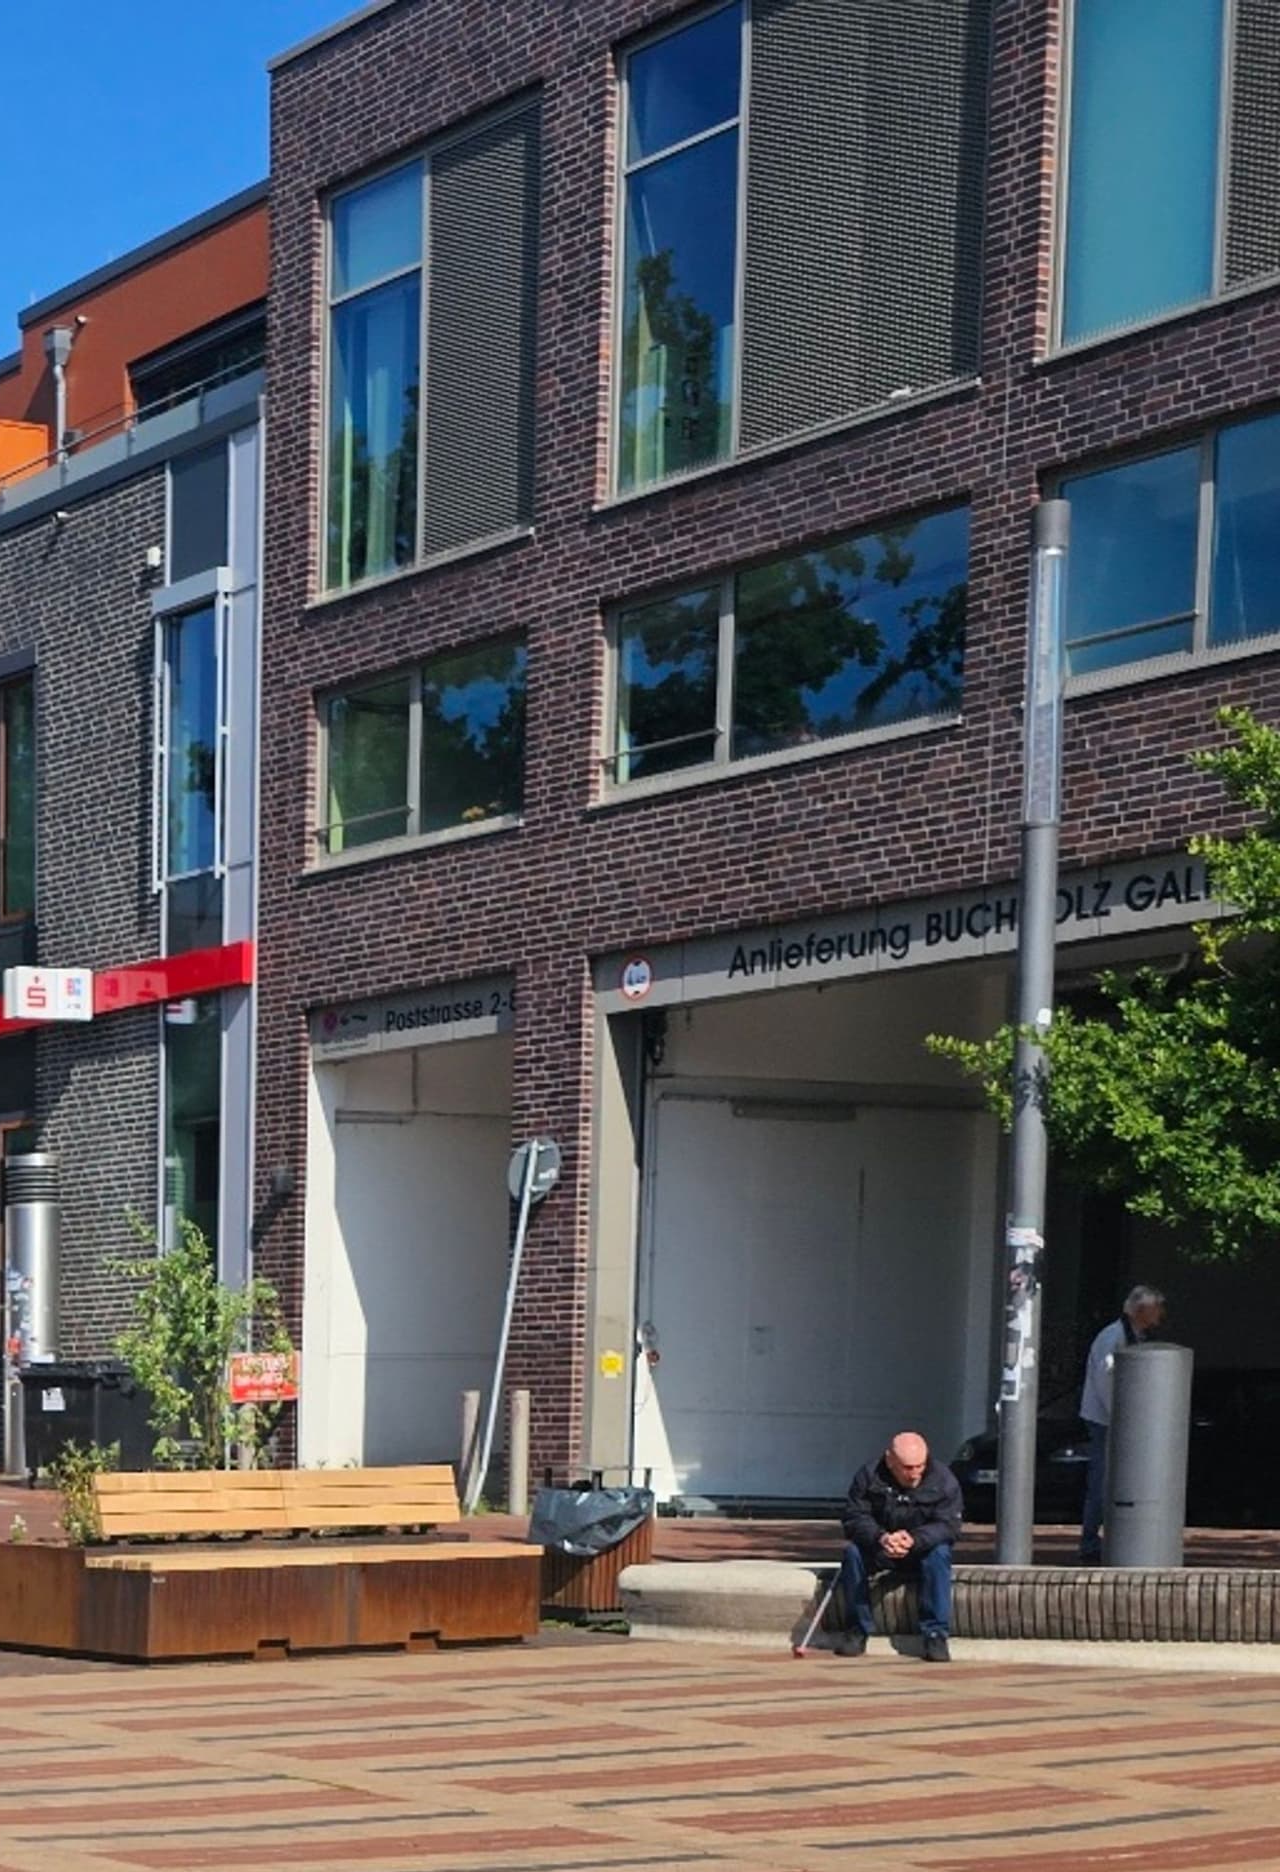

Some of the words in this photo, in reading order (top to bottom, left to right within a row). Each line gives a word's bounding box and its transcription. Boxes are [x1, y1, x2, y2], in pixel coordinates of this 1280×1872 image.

[727, 922, 911, 979] Anlieferung
[924, 880, 1112, 947] BUCHOLZ
[385, 1000, 483, 1034] Poststrasse
